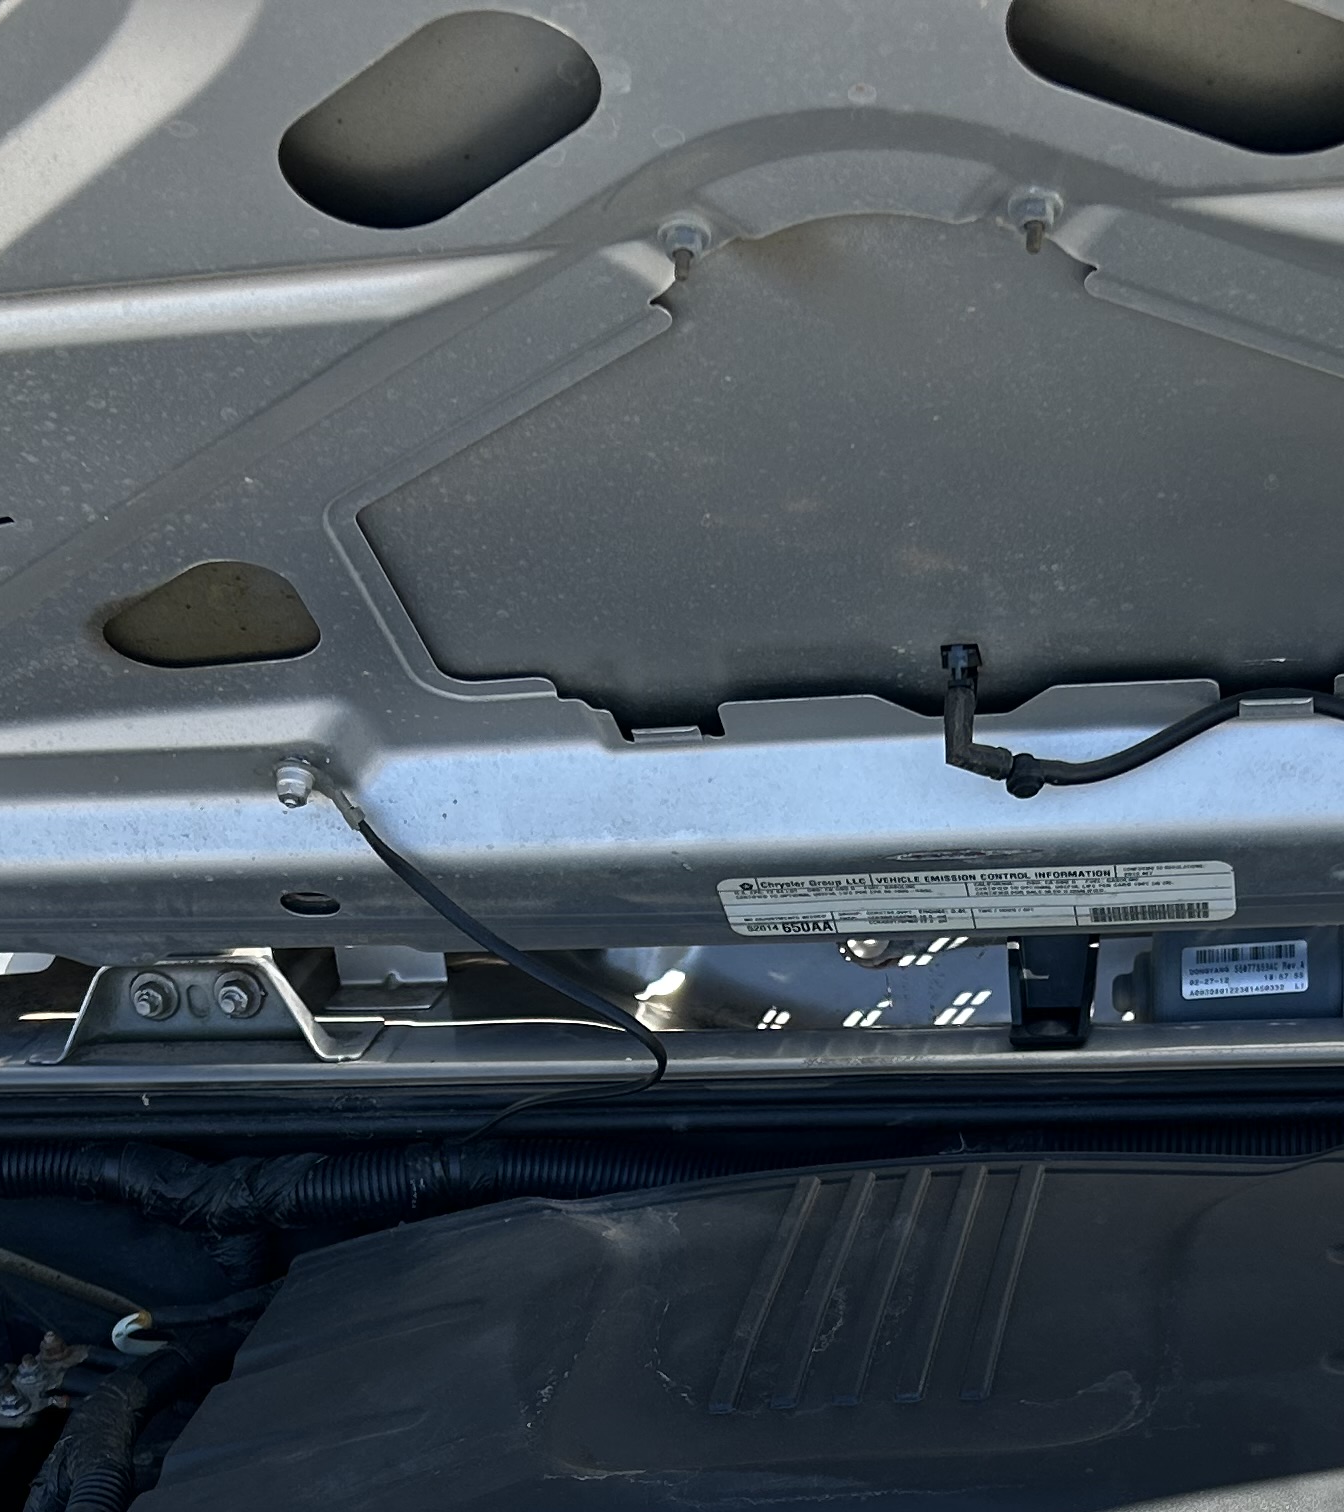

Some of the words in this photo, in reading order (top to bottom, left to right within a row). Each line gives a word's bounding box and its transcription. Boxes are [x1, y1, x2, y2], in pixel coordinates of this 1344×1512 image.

[874, 875, 920, 884] VEHICLE
[924, 872, 977, 882] EMISSION
[980, 872, 1031, 881] CONTROL
[1034, 869, 1112, 880] INFORMATION
[760, 880, 806, 891] Chrysler
[809, 878, 842, 888] Group
[845, 877, 866, 886] LLC
